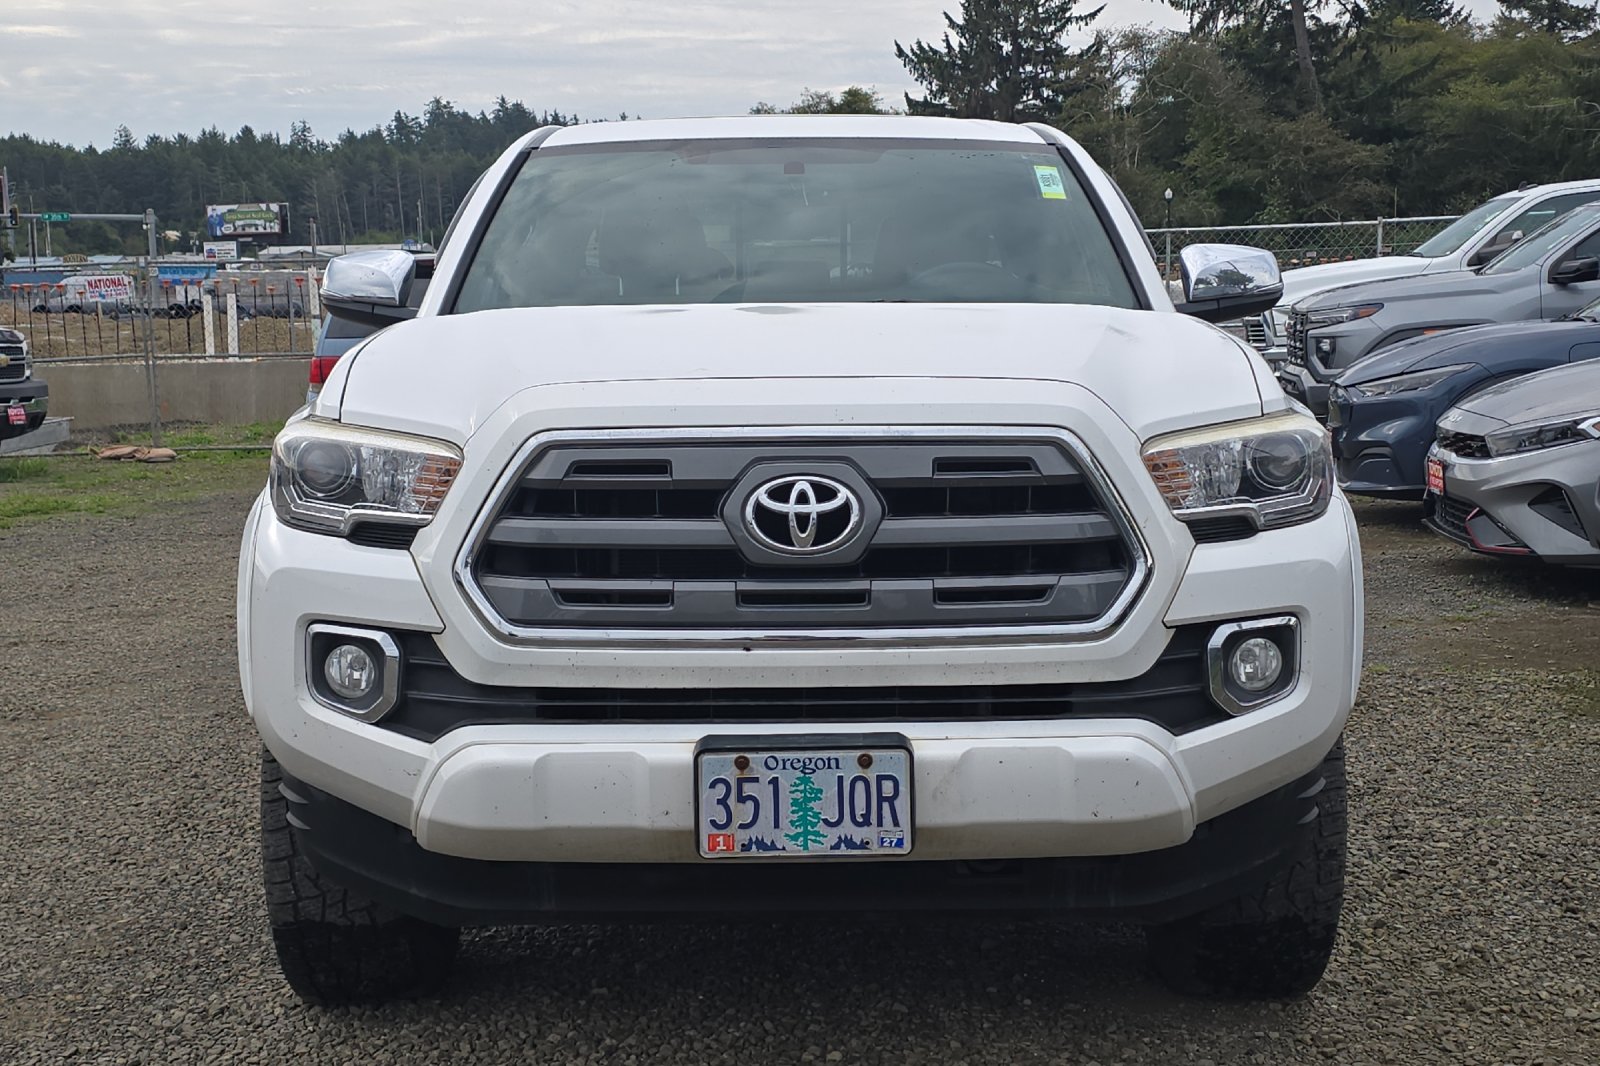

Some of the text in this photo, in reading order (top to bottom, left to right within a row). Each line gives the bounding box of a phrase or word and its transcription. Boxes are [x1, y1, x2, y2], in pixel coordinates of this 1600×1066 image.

[87, 277, 127, 290] NATIONAL
[764, 755, 842, 775] Oregon
[708, 774, 901, 831] 351 JQR
[716, 836, 727, 850] 1
[883, 838, 897, 847] 27
